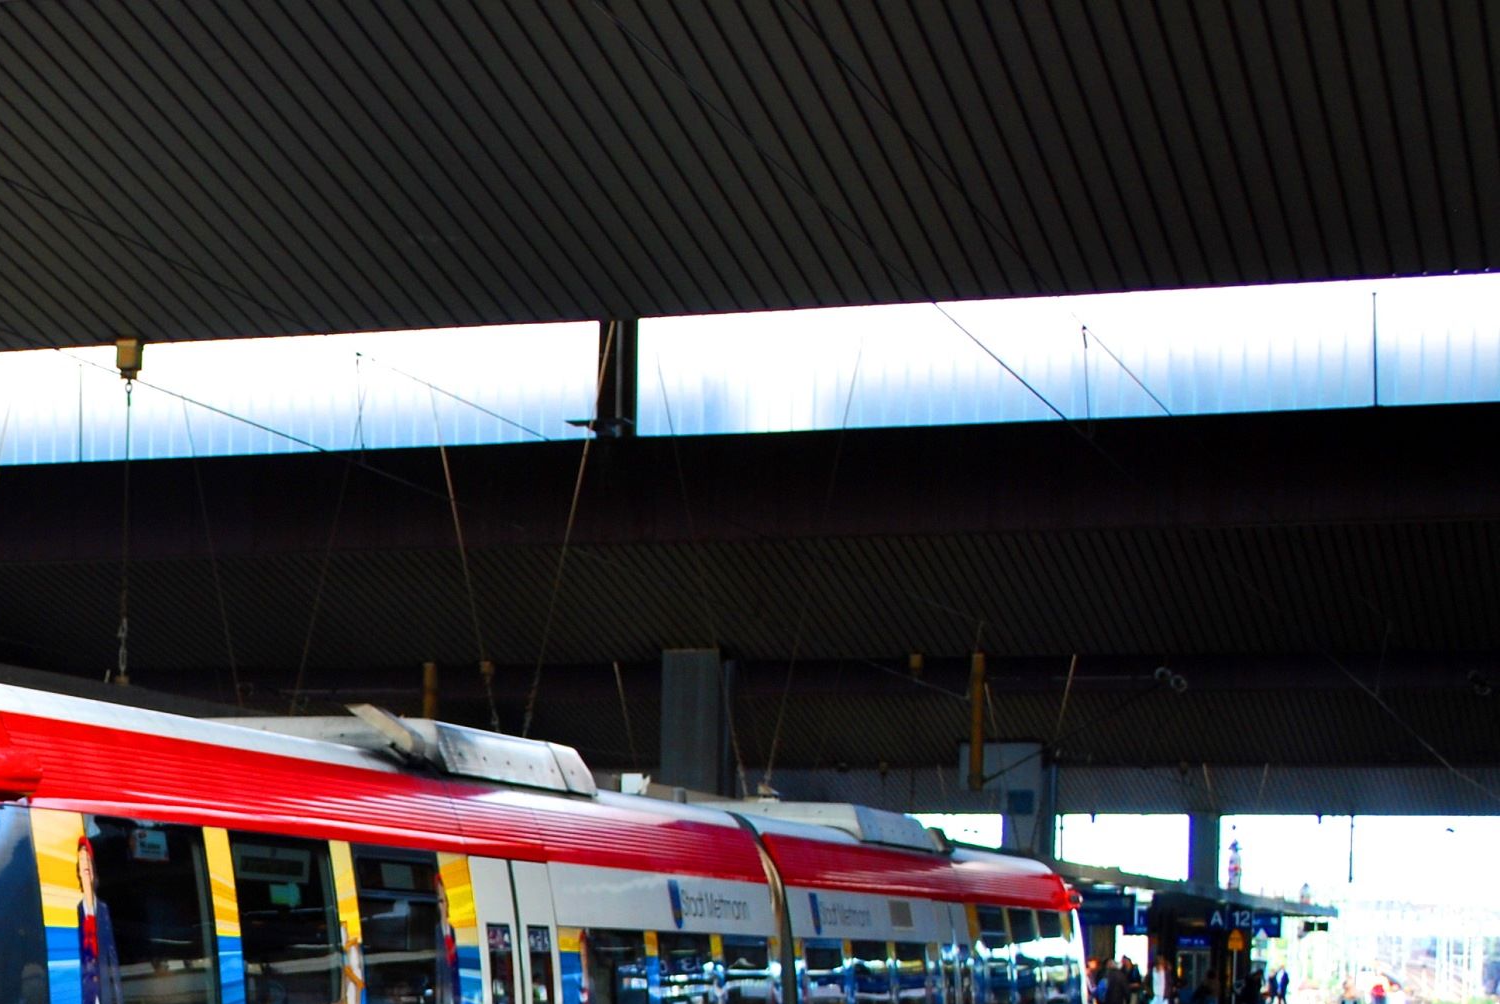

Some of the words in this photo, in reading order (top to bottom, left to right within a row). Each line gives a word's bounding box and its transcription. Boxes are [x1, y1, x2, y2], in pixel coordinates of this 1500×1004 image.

[680, 889, 704, 917] Stadt
[1210, 910, 1224, 927] A
[1232, 910, 1251, 927] 12
